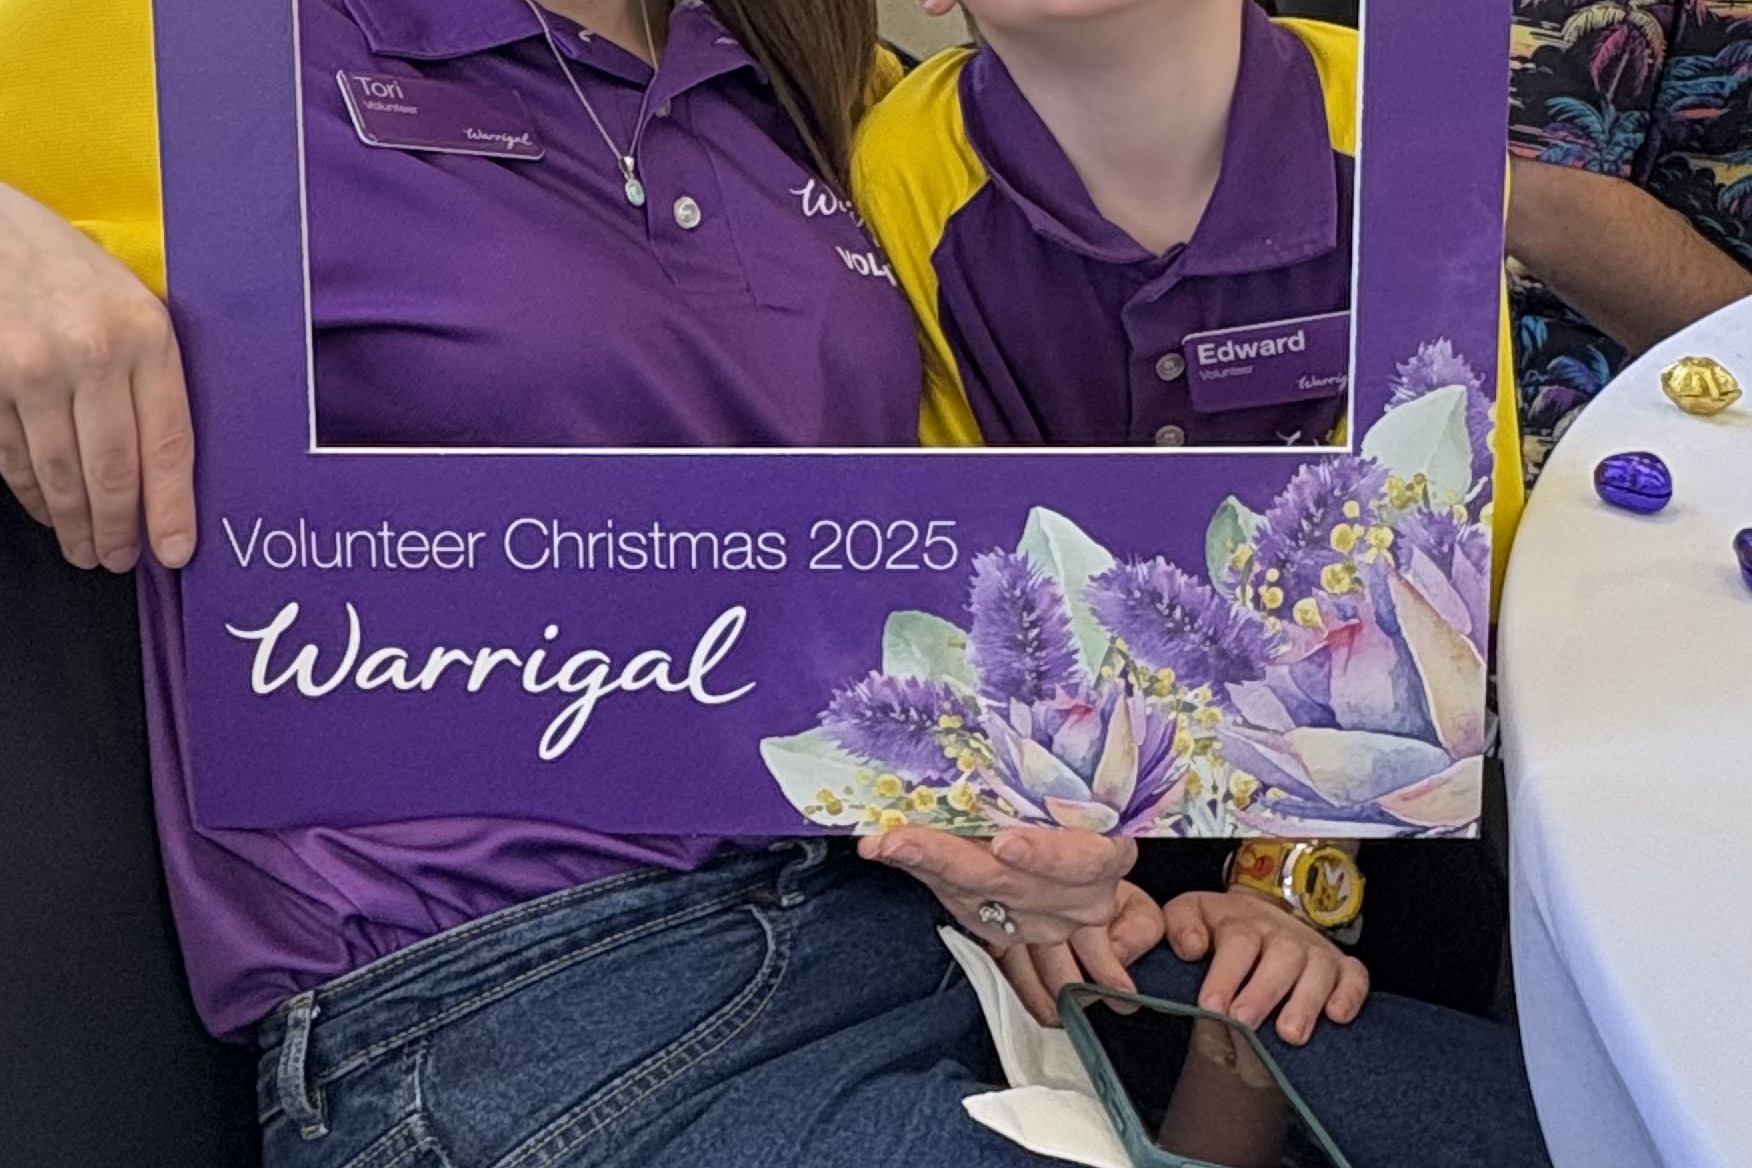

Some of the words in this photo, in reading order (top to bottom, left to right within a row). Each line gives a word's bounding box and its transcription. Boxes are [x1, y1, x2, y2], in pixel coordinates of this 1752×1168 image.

[353, 75, 404, 99] Tori
[462, 128, 533, 150] Warrigal
[1197, 329, 1306, 365] Edward
[222, 517, 486, 570] Volunteer
[504, 517, 787, 571] Christmas
[809, 519, 959, 571] 2025
[225, 601, 756, 761] Warrigal
